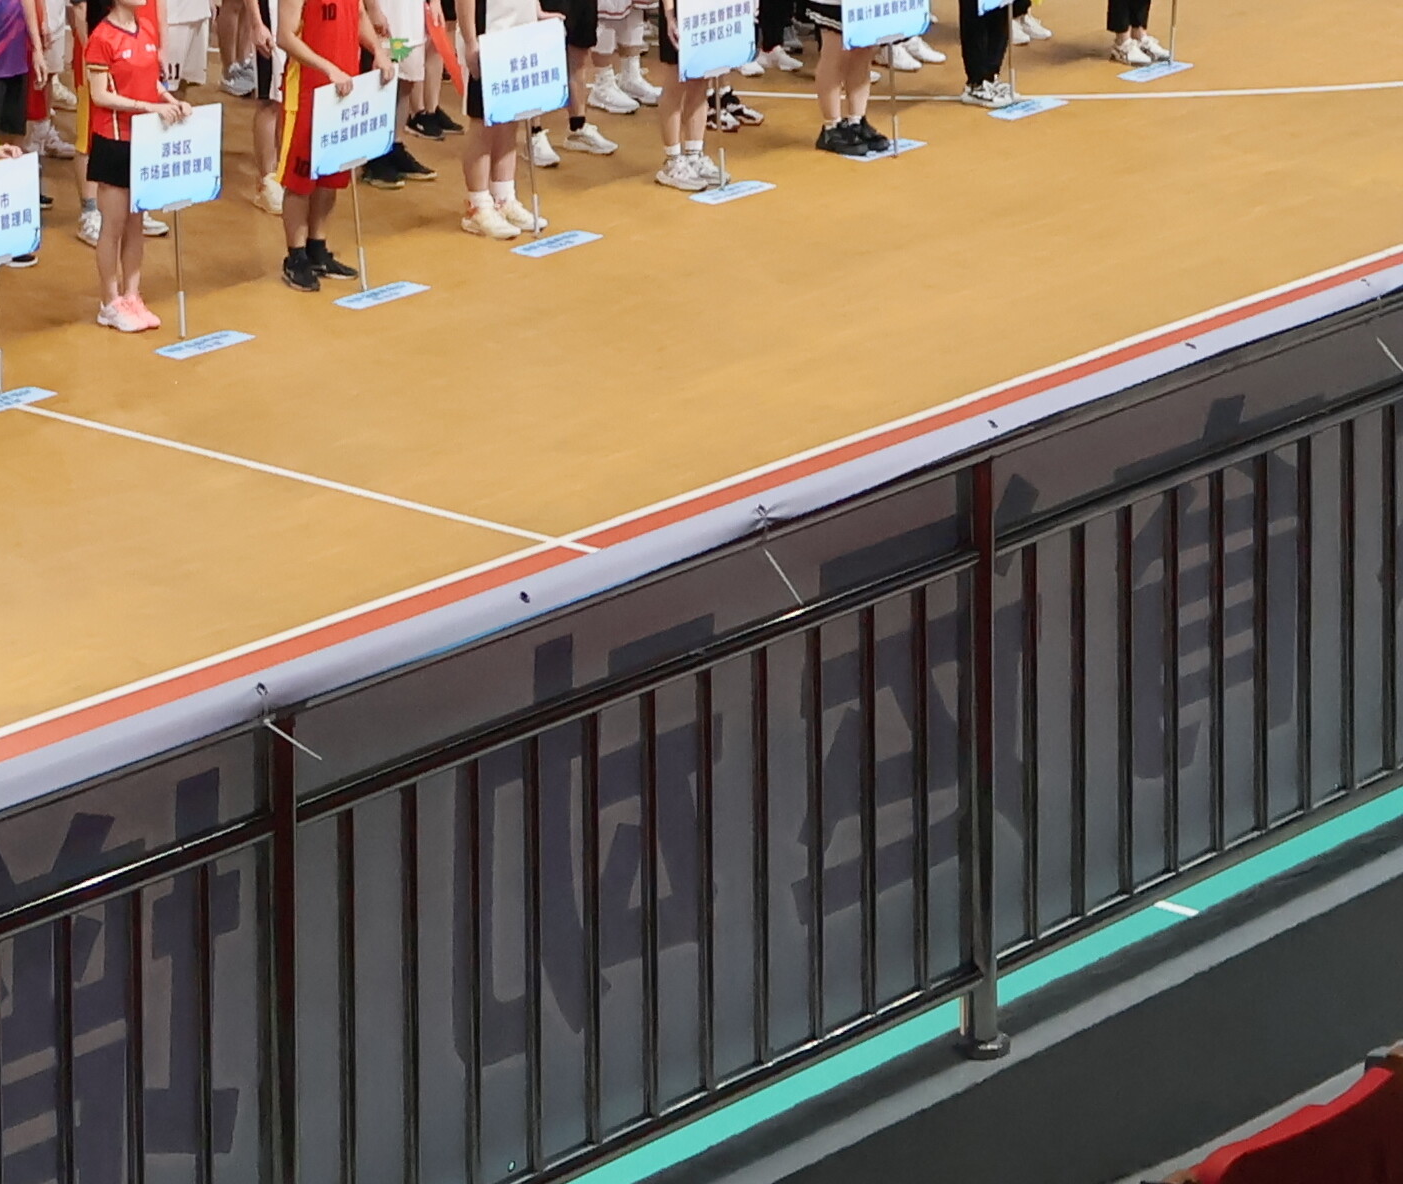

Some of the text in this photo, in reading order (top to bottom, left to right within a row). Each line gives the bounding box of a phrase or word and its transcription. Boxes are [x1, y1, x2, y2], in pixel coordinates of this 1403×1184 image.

[491, 66, 561, 97] 市场监督管理局
[340, 100, 370, 123] 和平县
[319, 113, 389, 148] 市场监督管理局
[161, 139, 193, 158] 源城区
[139, 156, 213, 182] 市场监督管理局
